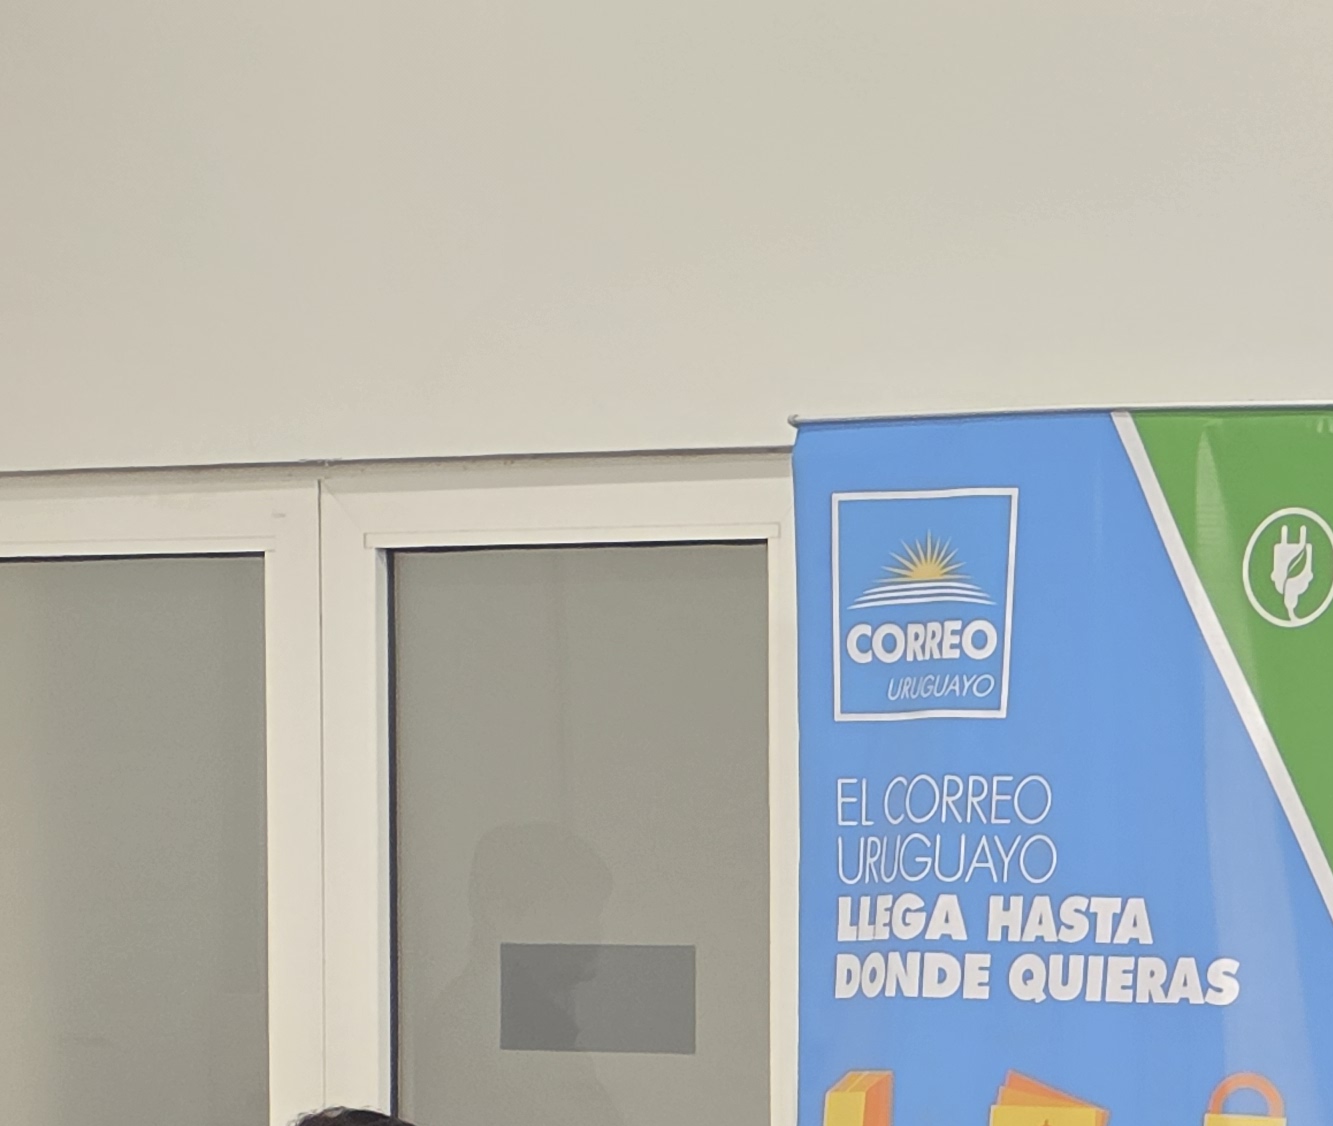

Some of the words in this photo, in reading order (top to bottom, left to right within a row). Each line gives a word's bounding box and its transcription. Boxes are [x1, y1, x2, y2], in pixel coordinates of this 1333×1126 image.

[846, 619, 998, 663] CORREO
[887, 673, 995, 701] URUGUAYO
[837, 778, 874, 826] EL
[884, 774, 1053, 826] CORREO
[837, 833, 1057, 884] URUGUAYO
[837, 893, 968, 942] LLEGA
[987, 895, 1154, 945] HASTA
[834, 952, 991, 999] DONDE
[1008, 954, 1241, 1005] QUIERAS
